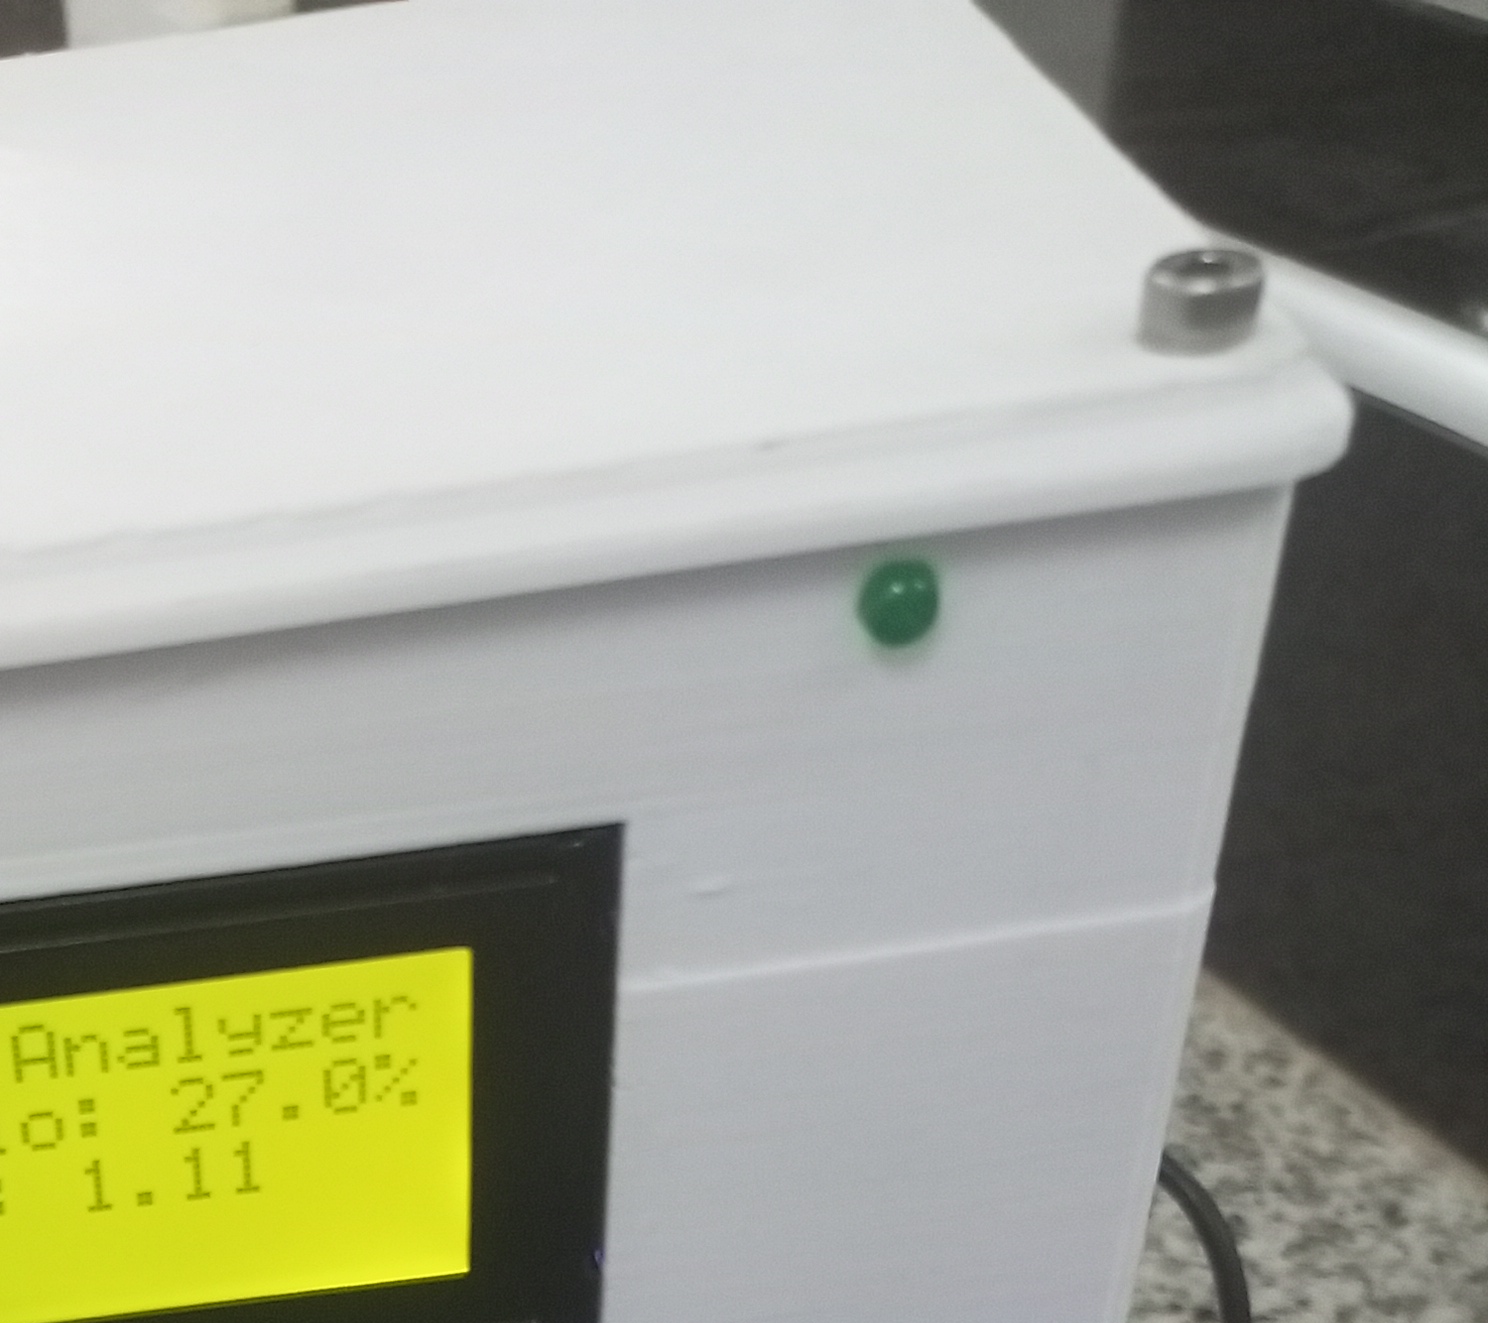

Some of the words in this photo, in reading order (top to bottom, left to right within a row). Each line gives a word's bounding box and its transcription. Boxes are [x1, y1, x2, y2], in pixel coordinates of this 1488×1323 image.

[10, 995, 419, 1081] Analyzer
[169, 1053, 420, 1135] 27.0%
[82, 1141, 261, 1213] 1.11
